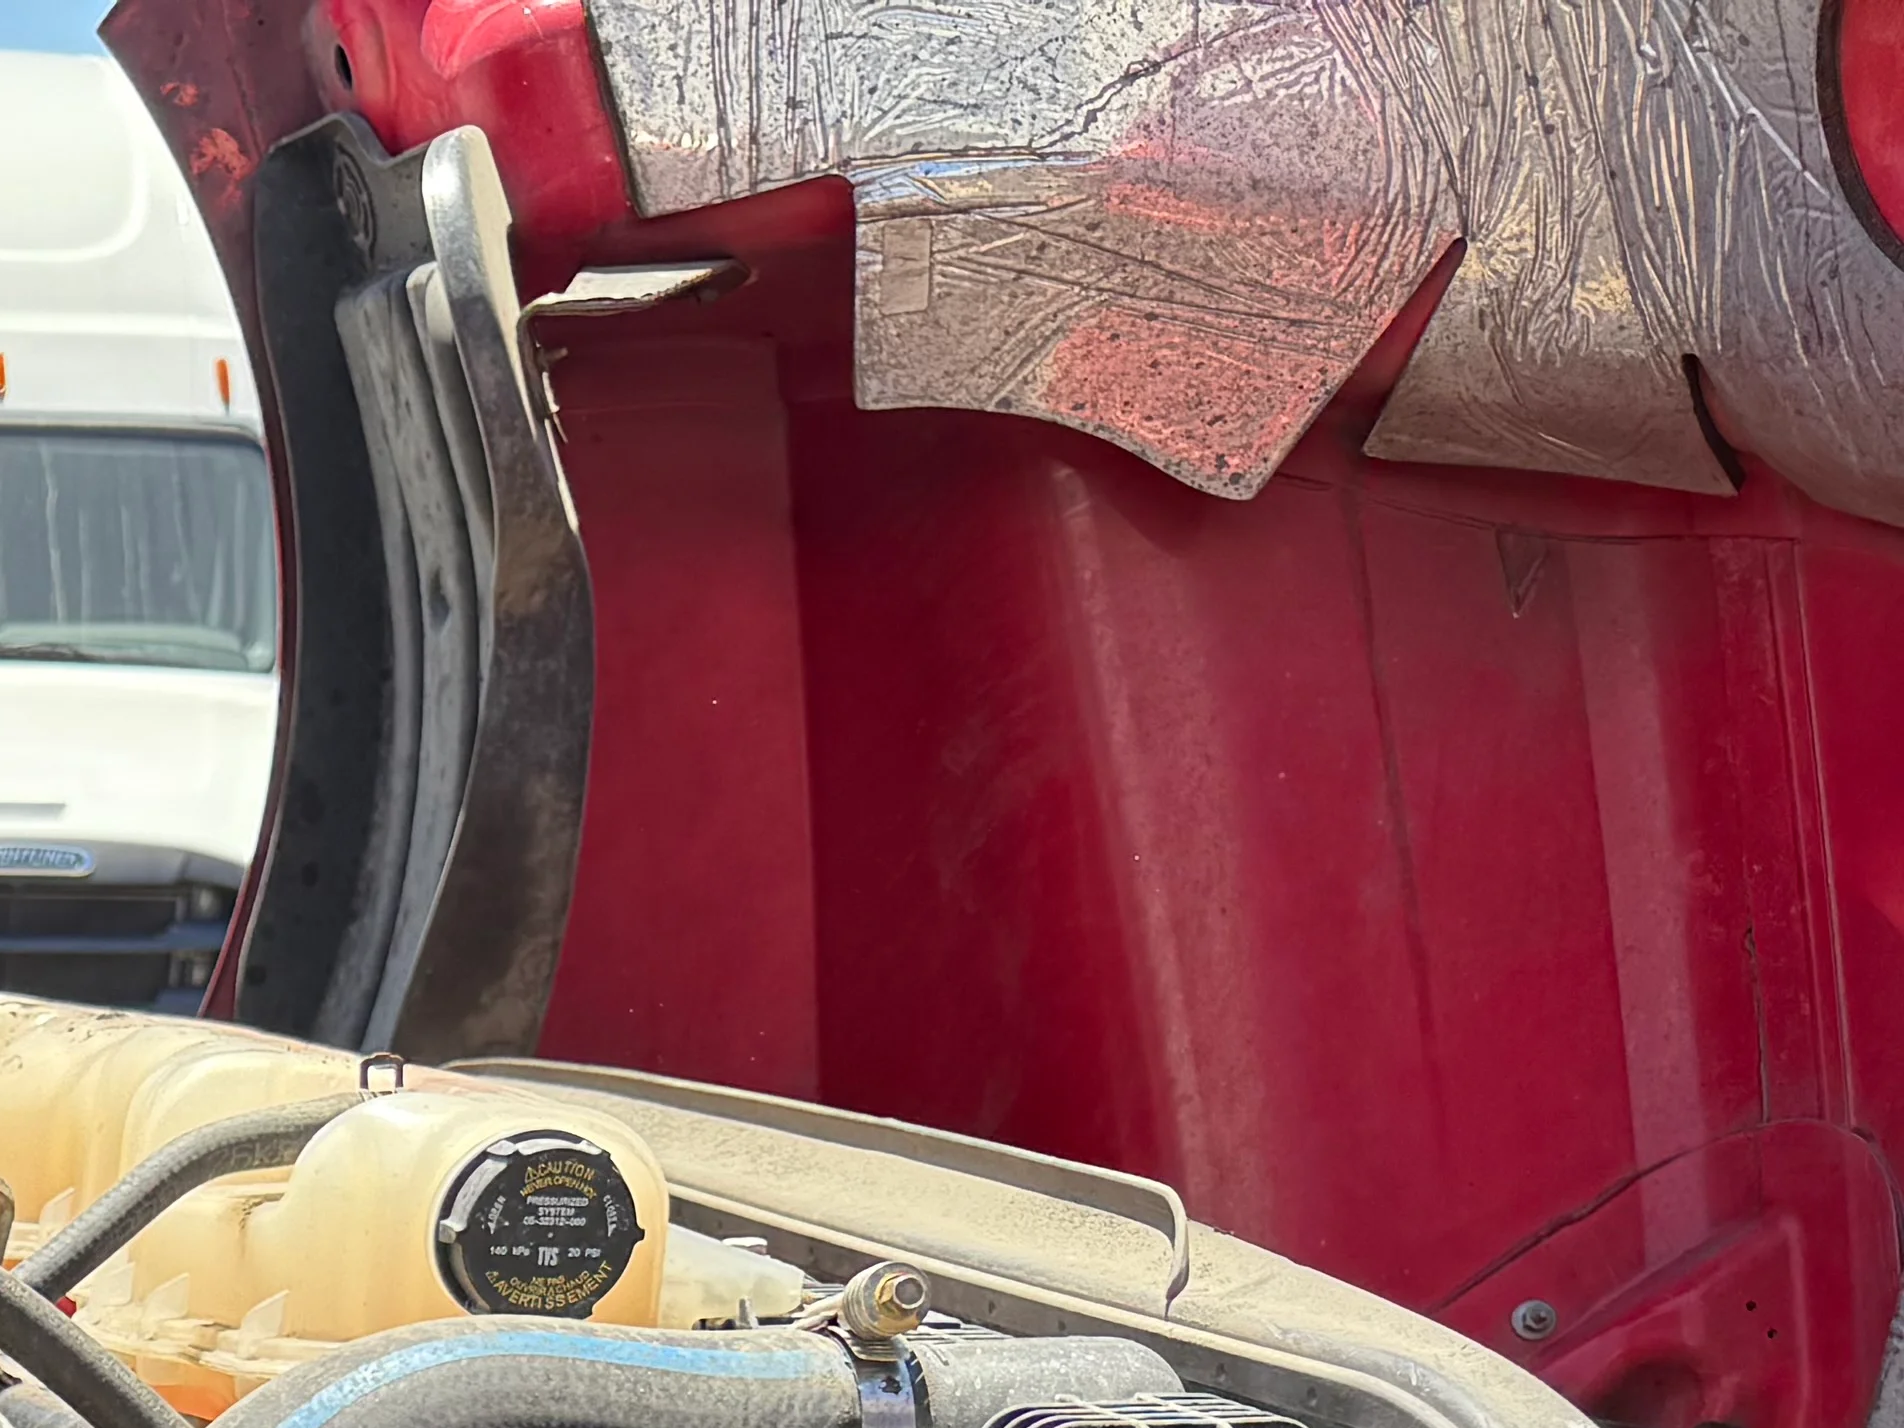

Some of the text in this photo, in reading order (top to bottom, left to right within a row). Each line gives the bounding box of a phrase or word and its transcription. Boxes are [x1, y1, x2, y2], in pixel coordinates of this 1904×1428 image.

[538, 1160, 596, 1180] CAUTION
[526, 1196, 589, 1207] PRESSURIZED
[538, 1207, 575, 1216] SYSTEM
[538, 1246, 560, 1266] TVS
[568, 1247, 601, 1258] 20 PSI
[493, 1260, 612, 1310] AVERTISSEMENT
